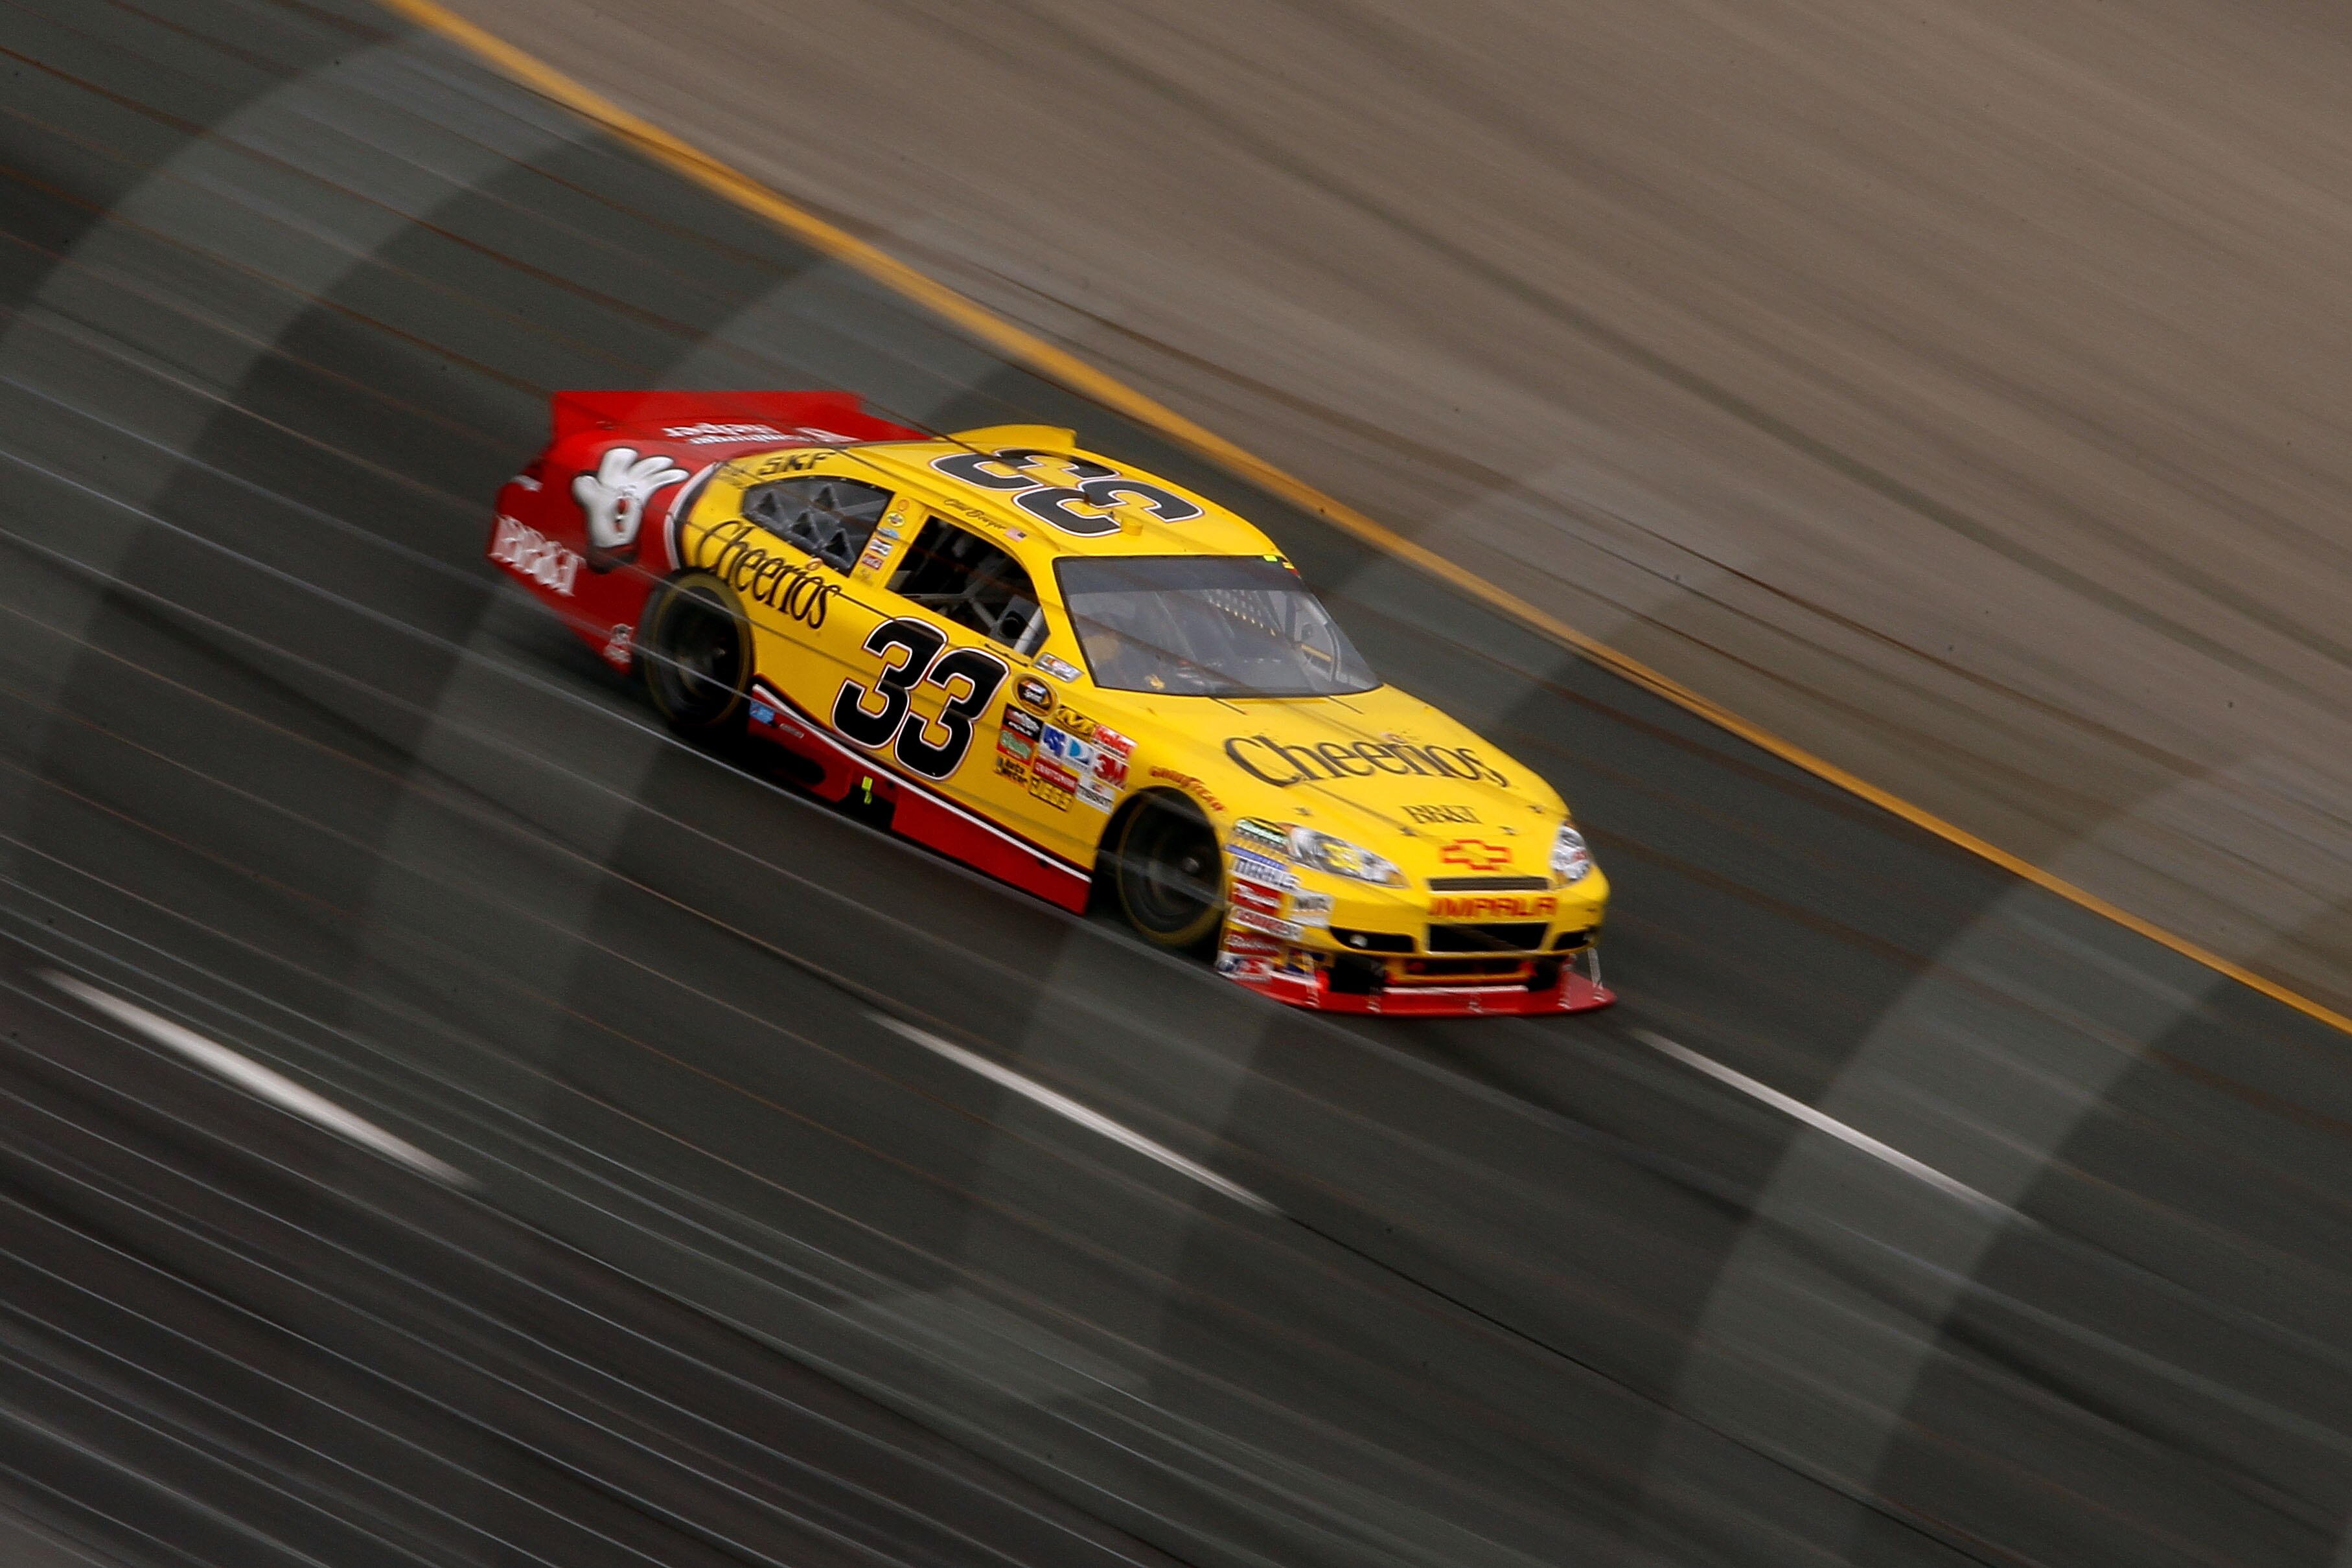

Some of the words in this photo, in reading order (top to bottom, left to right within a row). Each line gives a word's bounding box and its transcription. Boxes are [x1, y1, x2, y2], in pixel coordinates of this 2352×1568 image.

[757, 452, 836, 476] SKF
[695, 520, 841, 629] Cheerios
[831, 616, 1011, 781] 33
[1223, 733, 1509, 788] Cheerios
